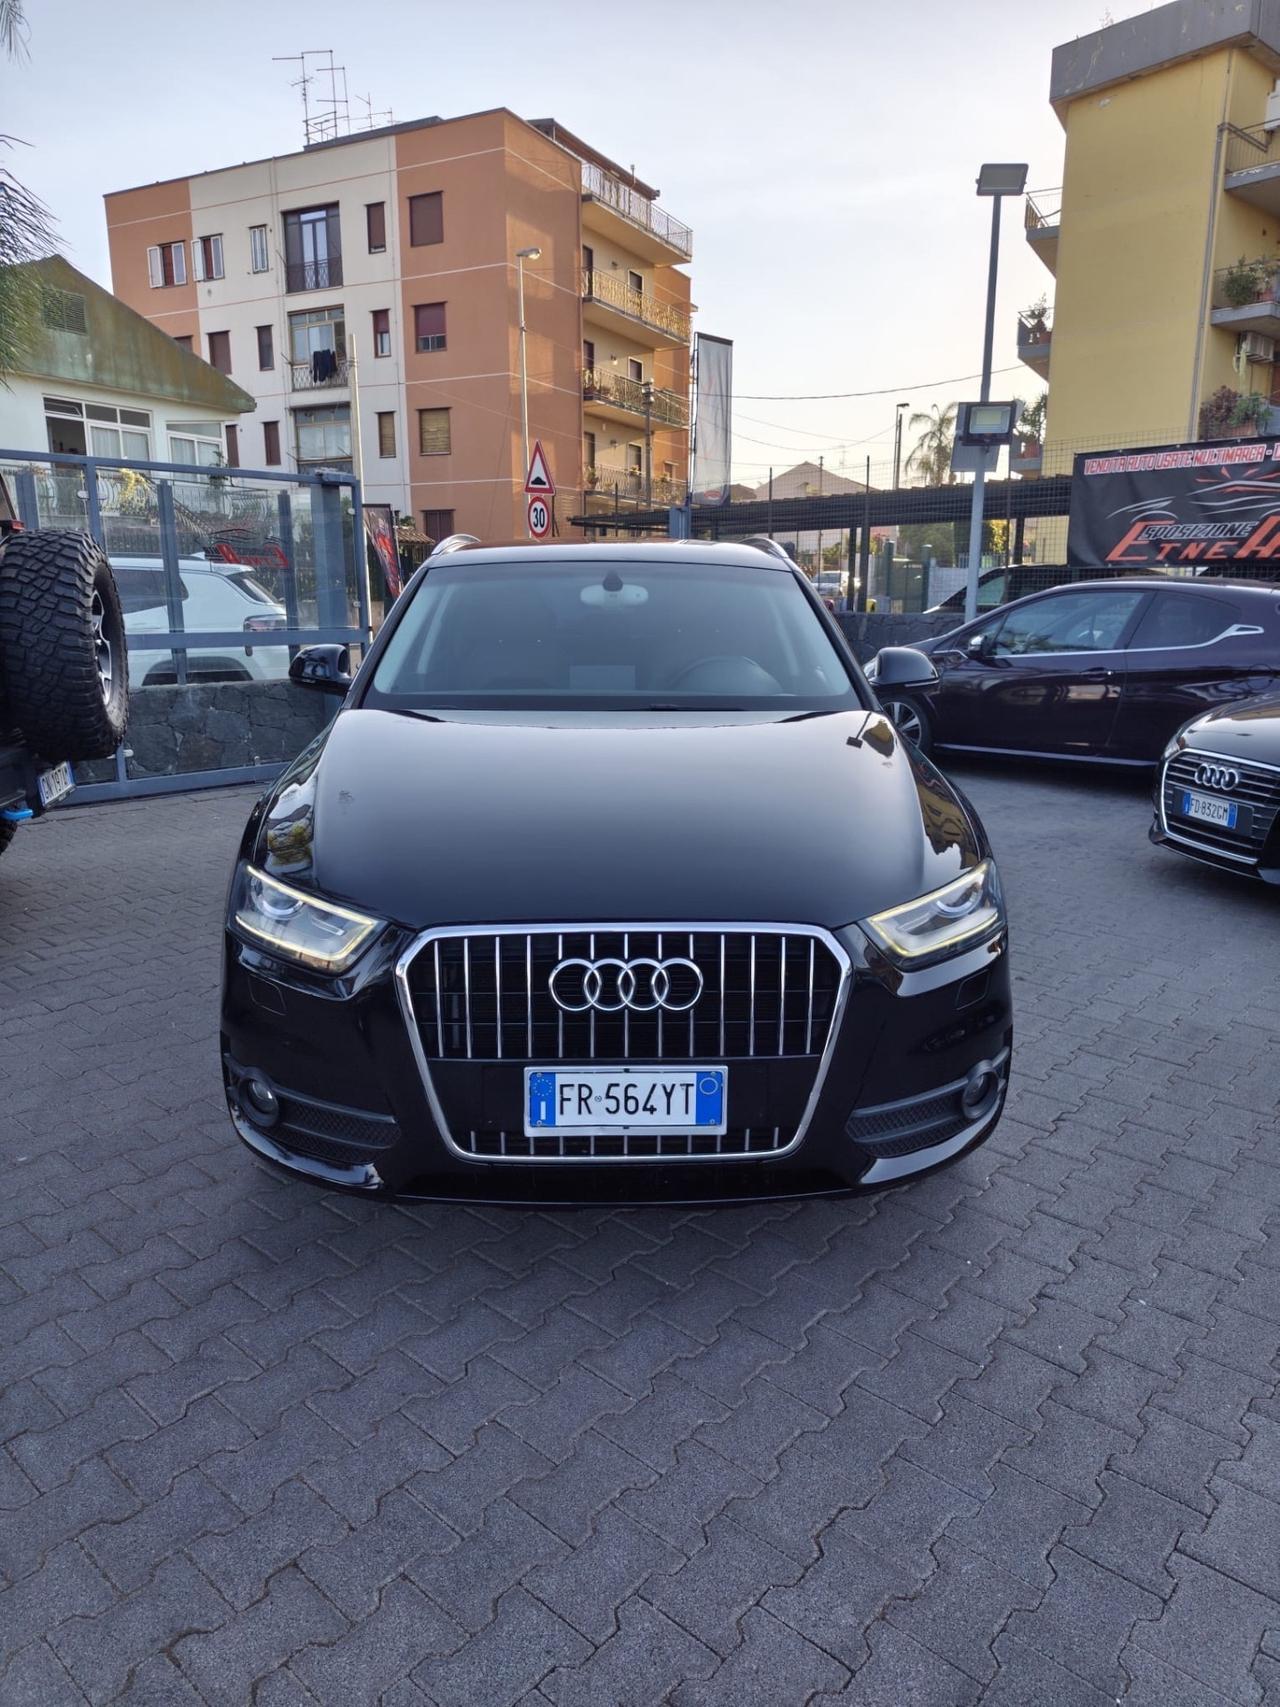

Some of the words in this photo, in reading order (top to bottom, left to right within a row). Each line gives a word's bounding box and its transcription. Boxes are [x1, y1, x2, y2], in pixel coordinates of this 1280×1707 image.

[1126, 453, 1157, 472] AUTO
[1192, 444, 1267, 467] MULTIMARCA
[533, 507, 546, 528] 30
